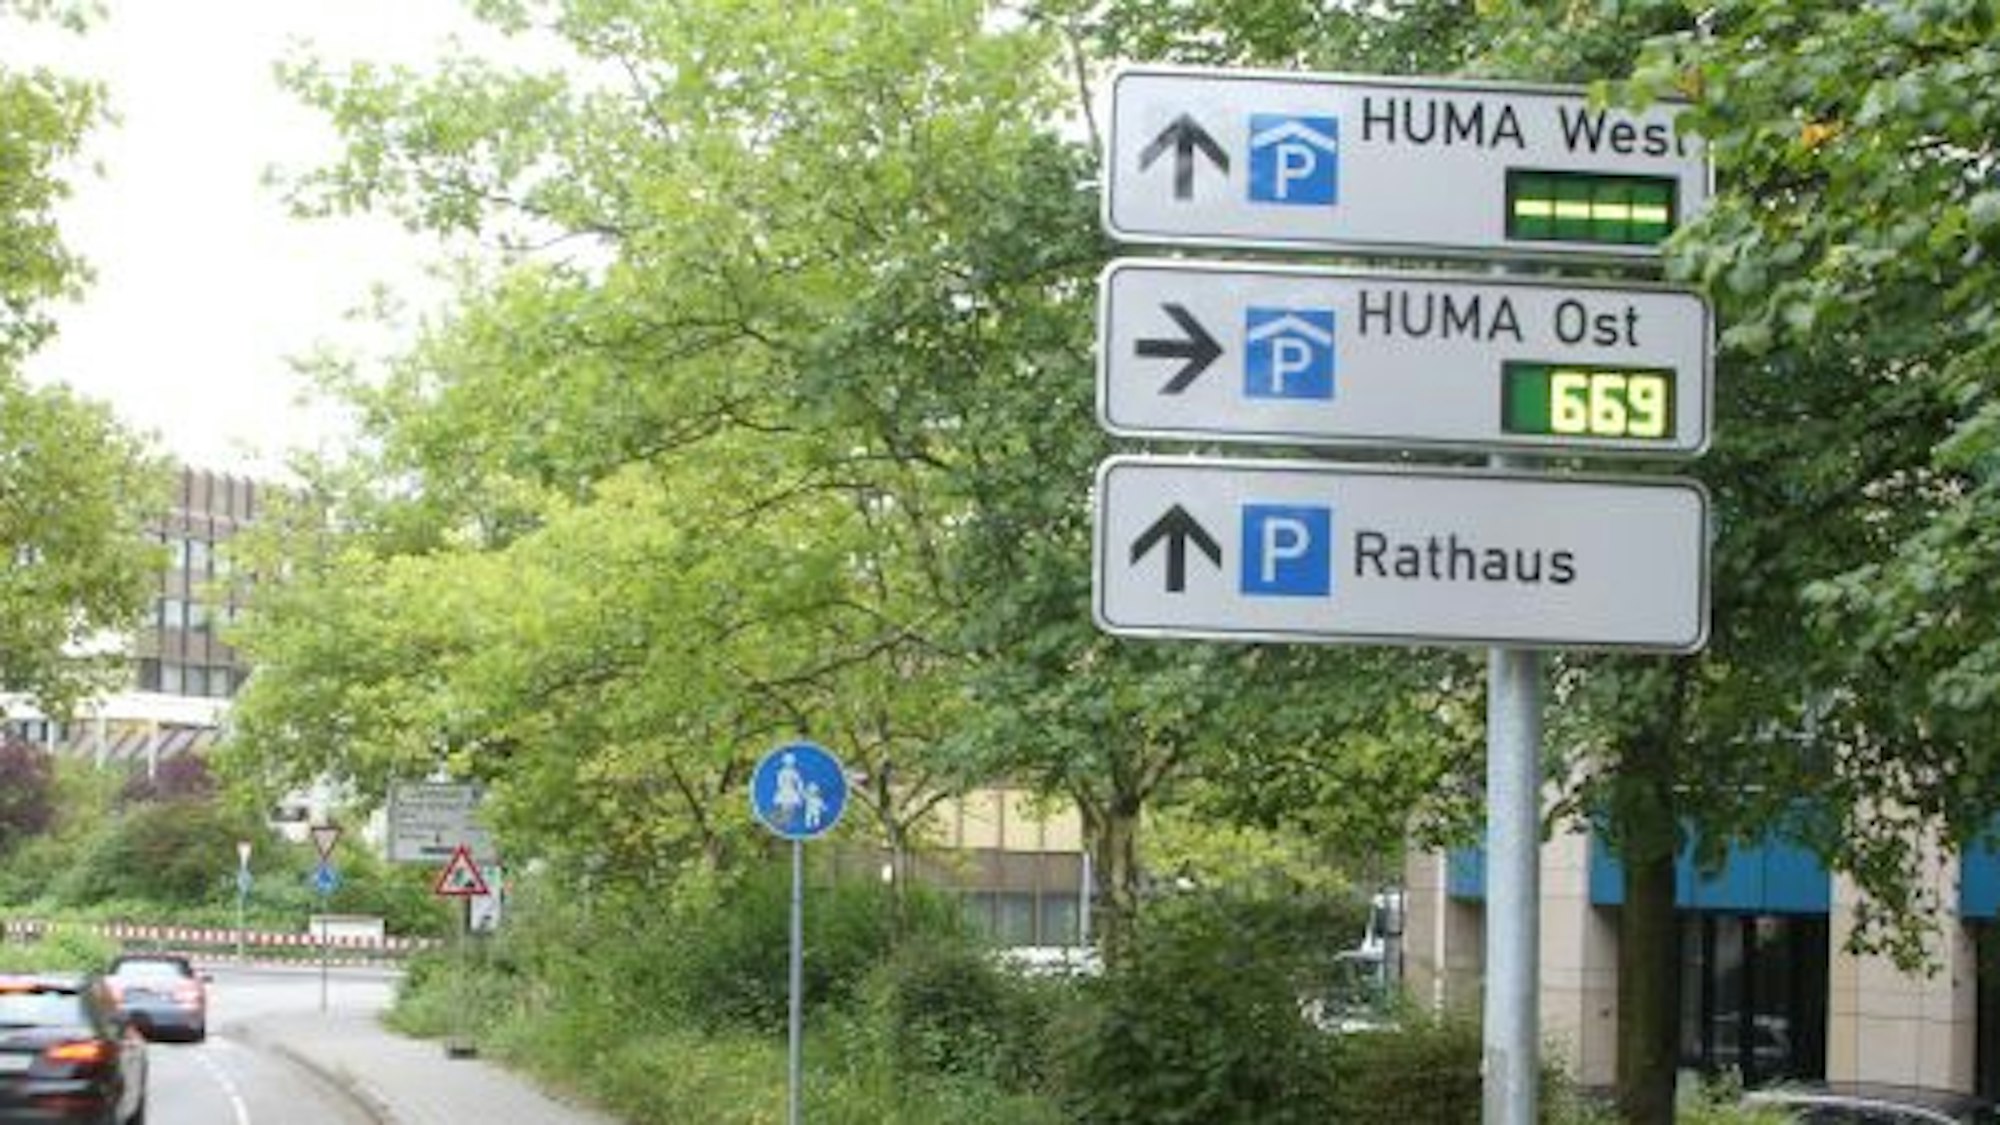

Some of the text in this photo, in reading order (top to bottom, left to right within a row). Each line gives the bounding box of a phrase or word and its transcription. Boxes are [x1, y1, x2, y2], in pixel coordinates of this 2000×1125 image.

[1362, 98, 1525, 149] HUMA
[1276, 145, 1315, 199] P
[1359, 291, 1640, 347] HUMA Ost
[1272, 338, 1312, 393] P
[1550, 373, 1666, 436] 669
[1262, 517, 1310, 583] P
[1354, 532, 1577, 585] Rathaus
